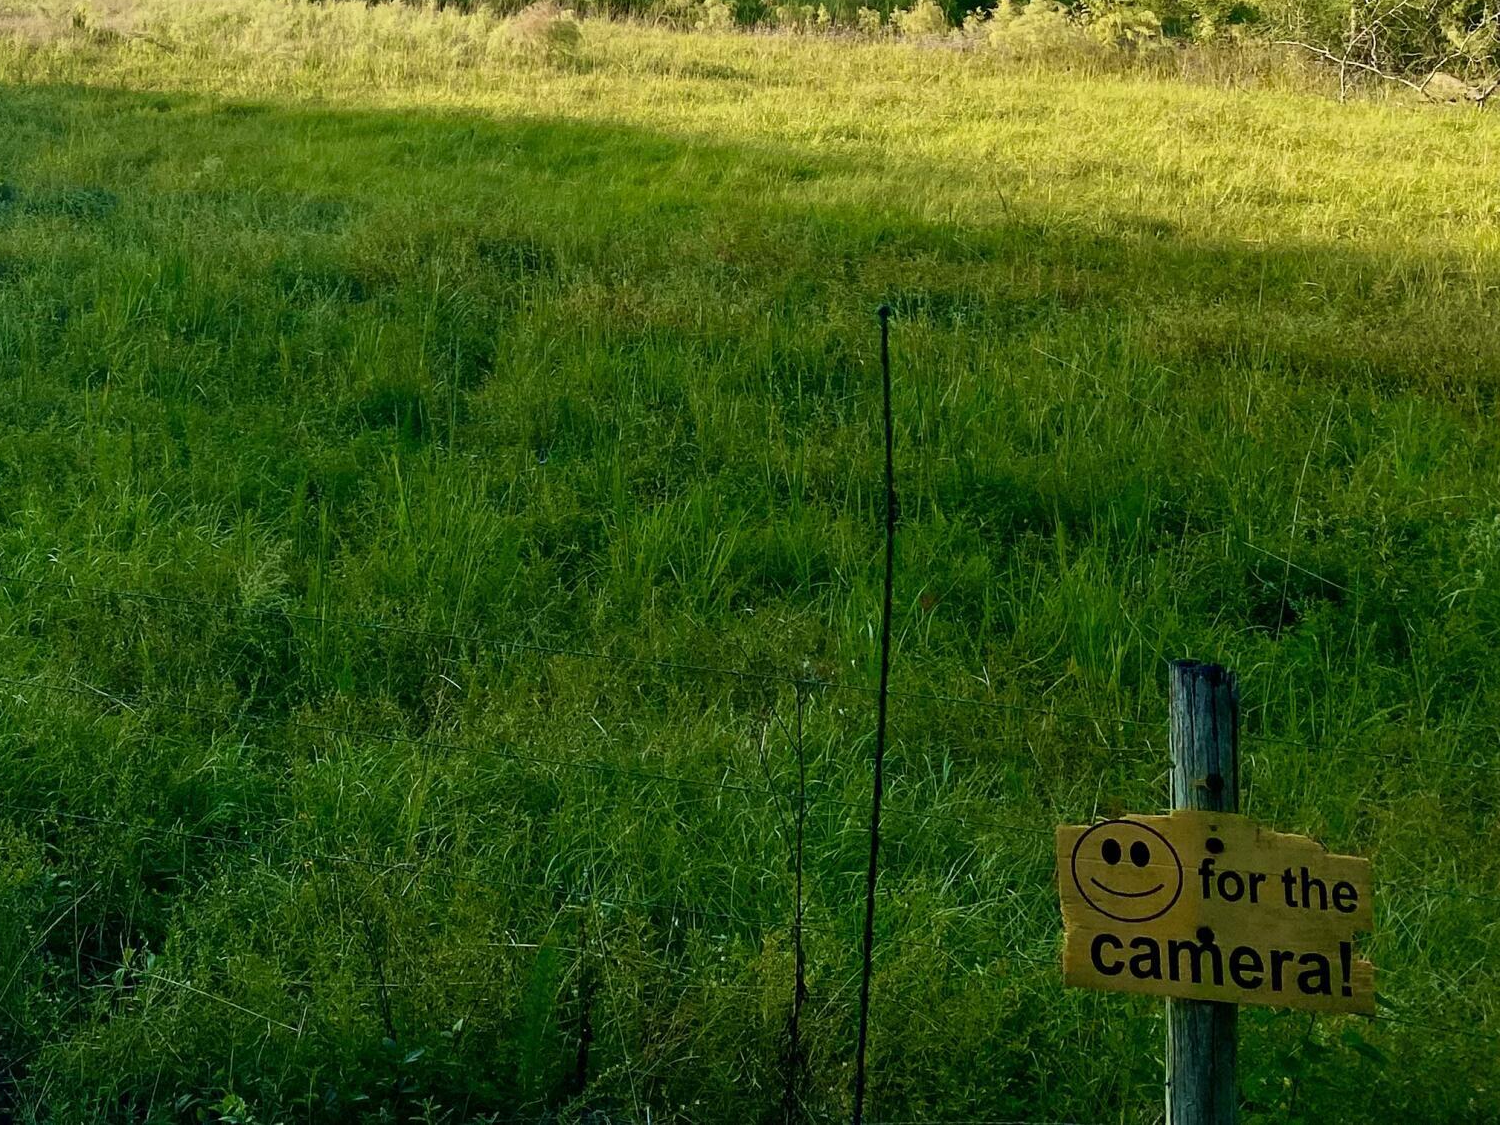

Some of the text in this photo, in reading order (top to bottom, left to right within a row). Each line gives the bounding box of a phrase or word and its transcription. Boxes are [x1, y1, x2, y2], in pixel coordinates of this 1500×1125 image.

[1198, 858, 1358, 913] for the
[1090, 932, 1353, 997] camera!
